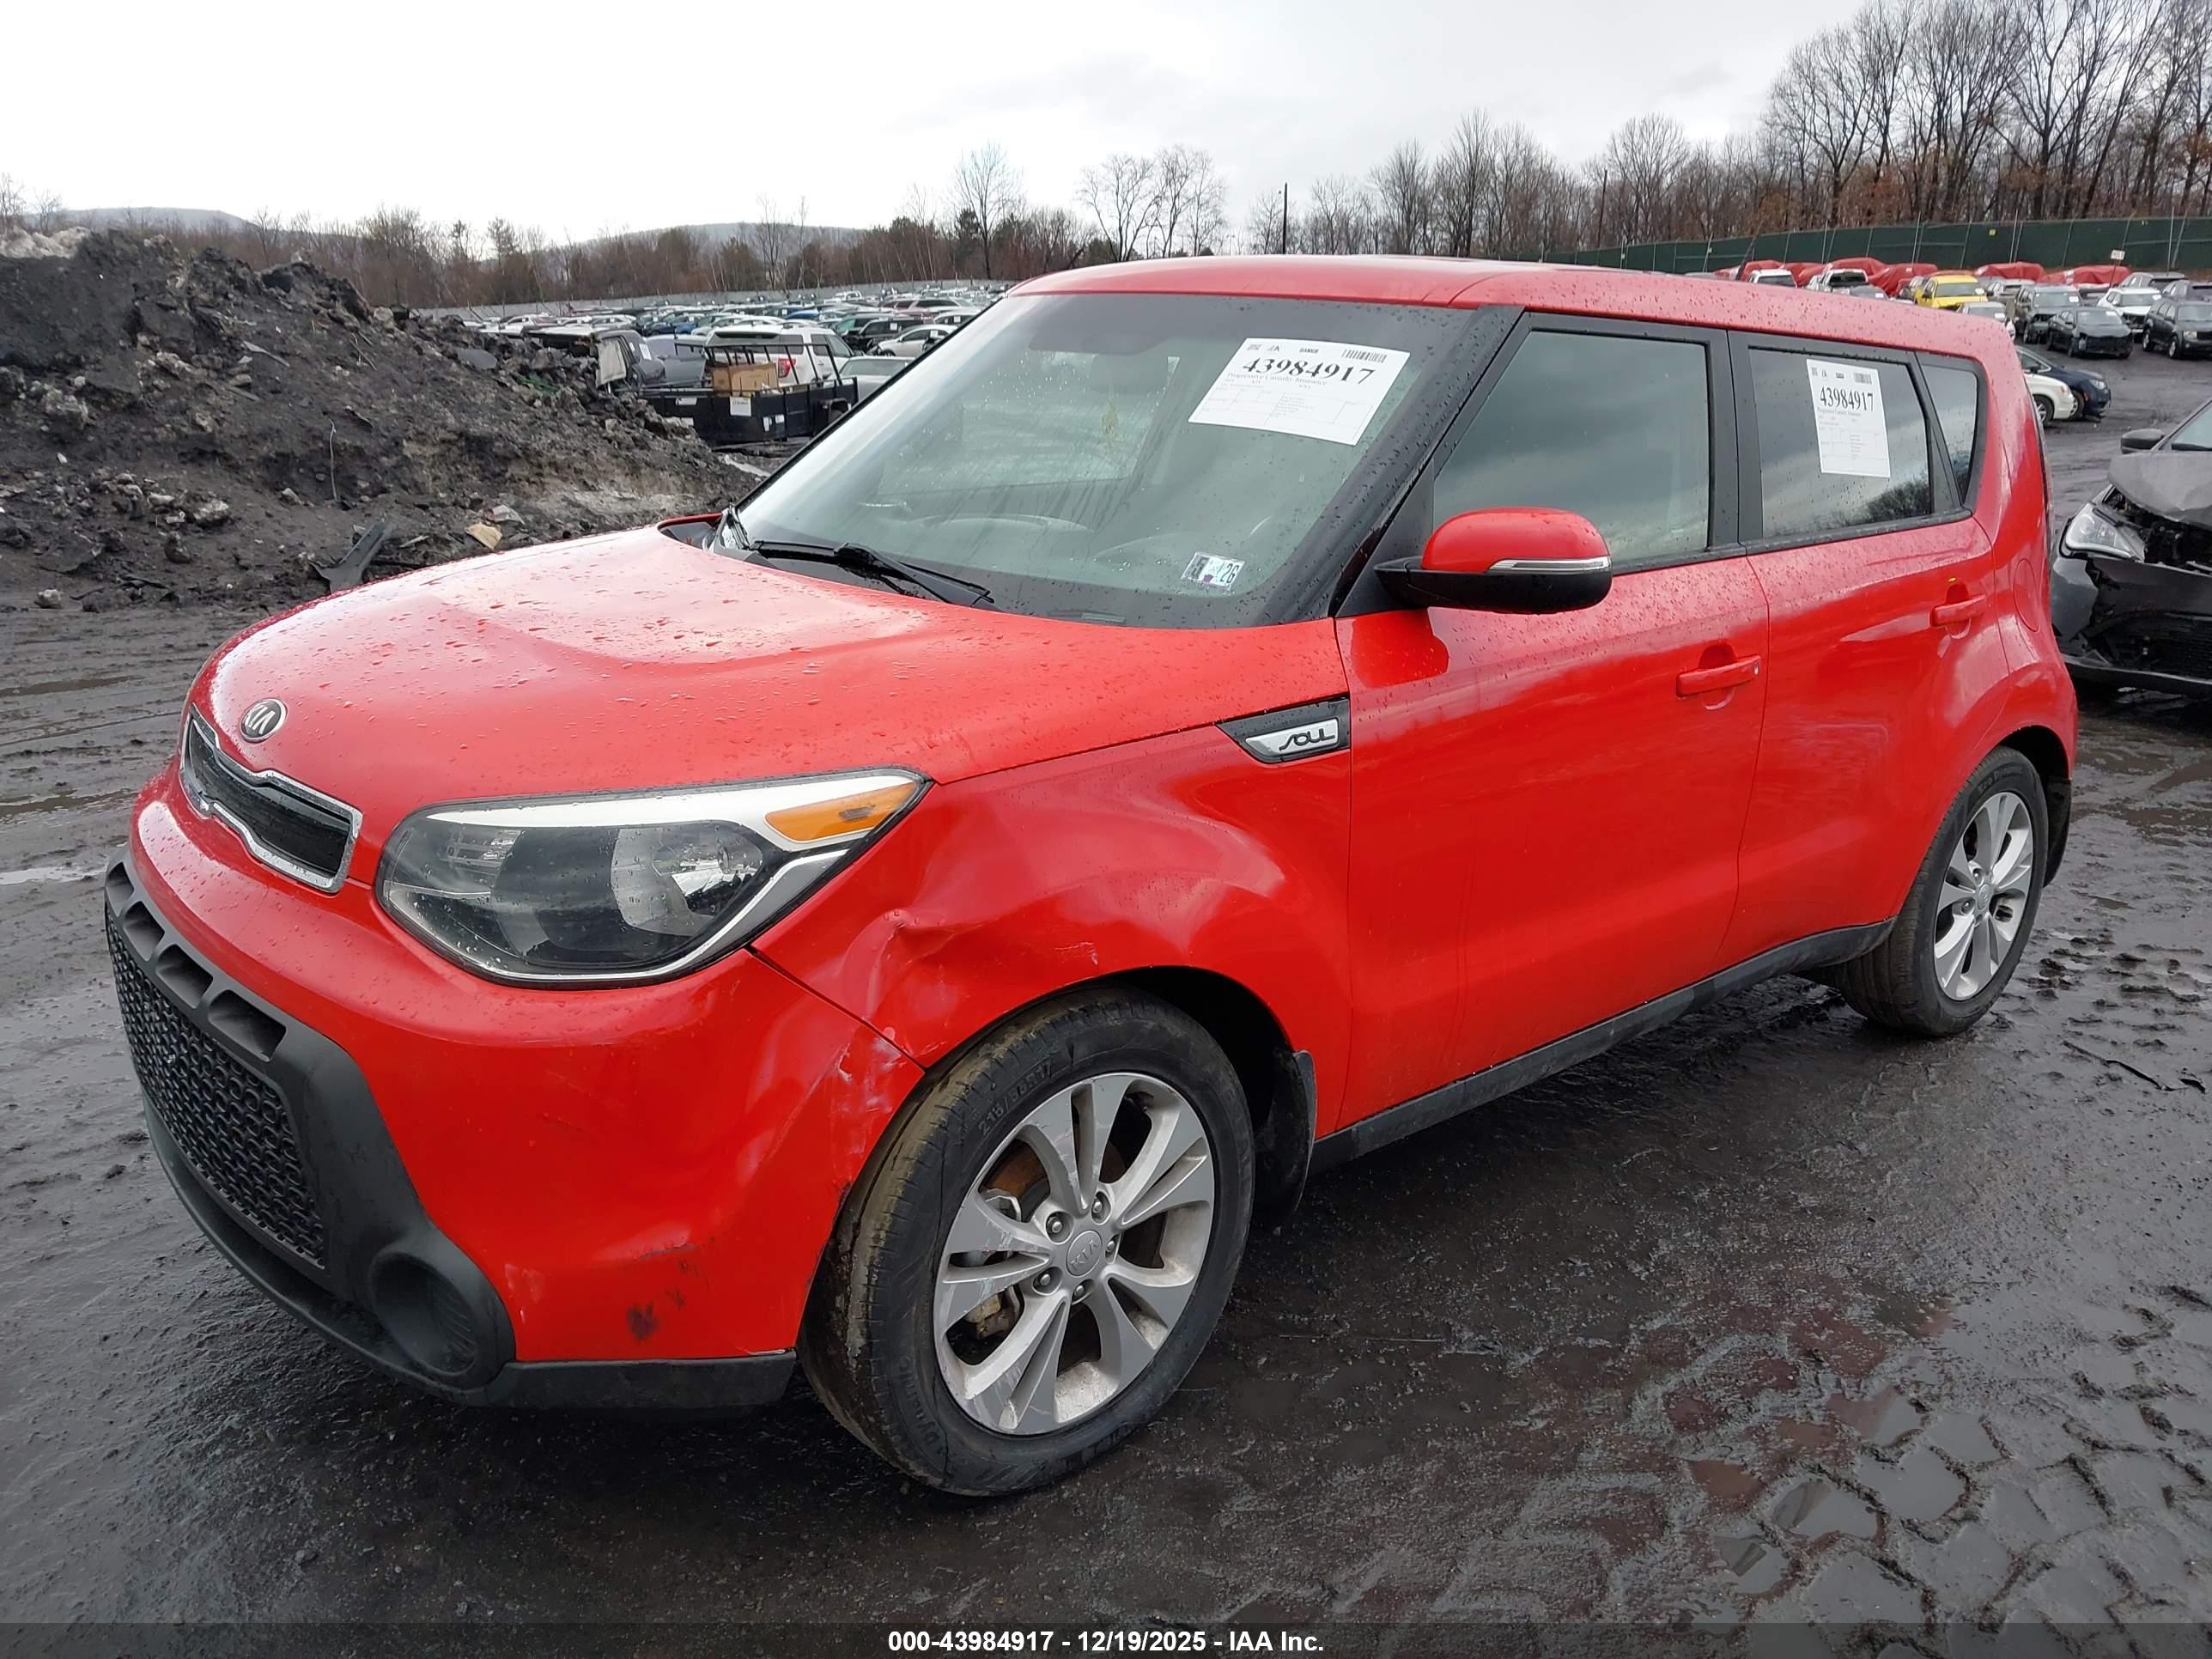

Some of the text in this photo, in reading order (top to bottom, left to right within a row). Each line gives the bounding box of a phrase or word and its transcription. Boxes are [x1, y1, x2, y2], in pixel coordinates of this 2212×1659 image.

[1243, 356, 1376, 385] 43984917
[1820, 386, 1874, 412] 43984917
[1220, 563, 1239, 584] 26
[244, 704, 276, 735] KIA
[1279, 728, 1336, 751] SOUL
[1071, 1239, 1098, 1272] KIA
